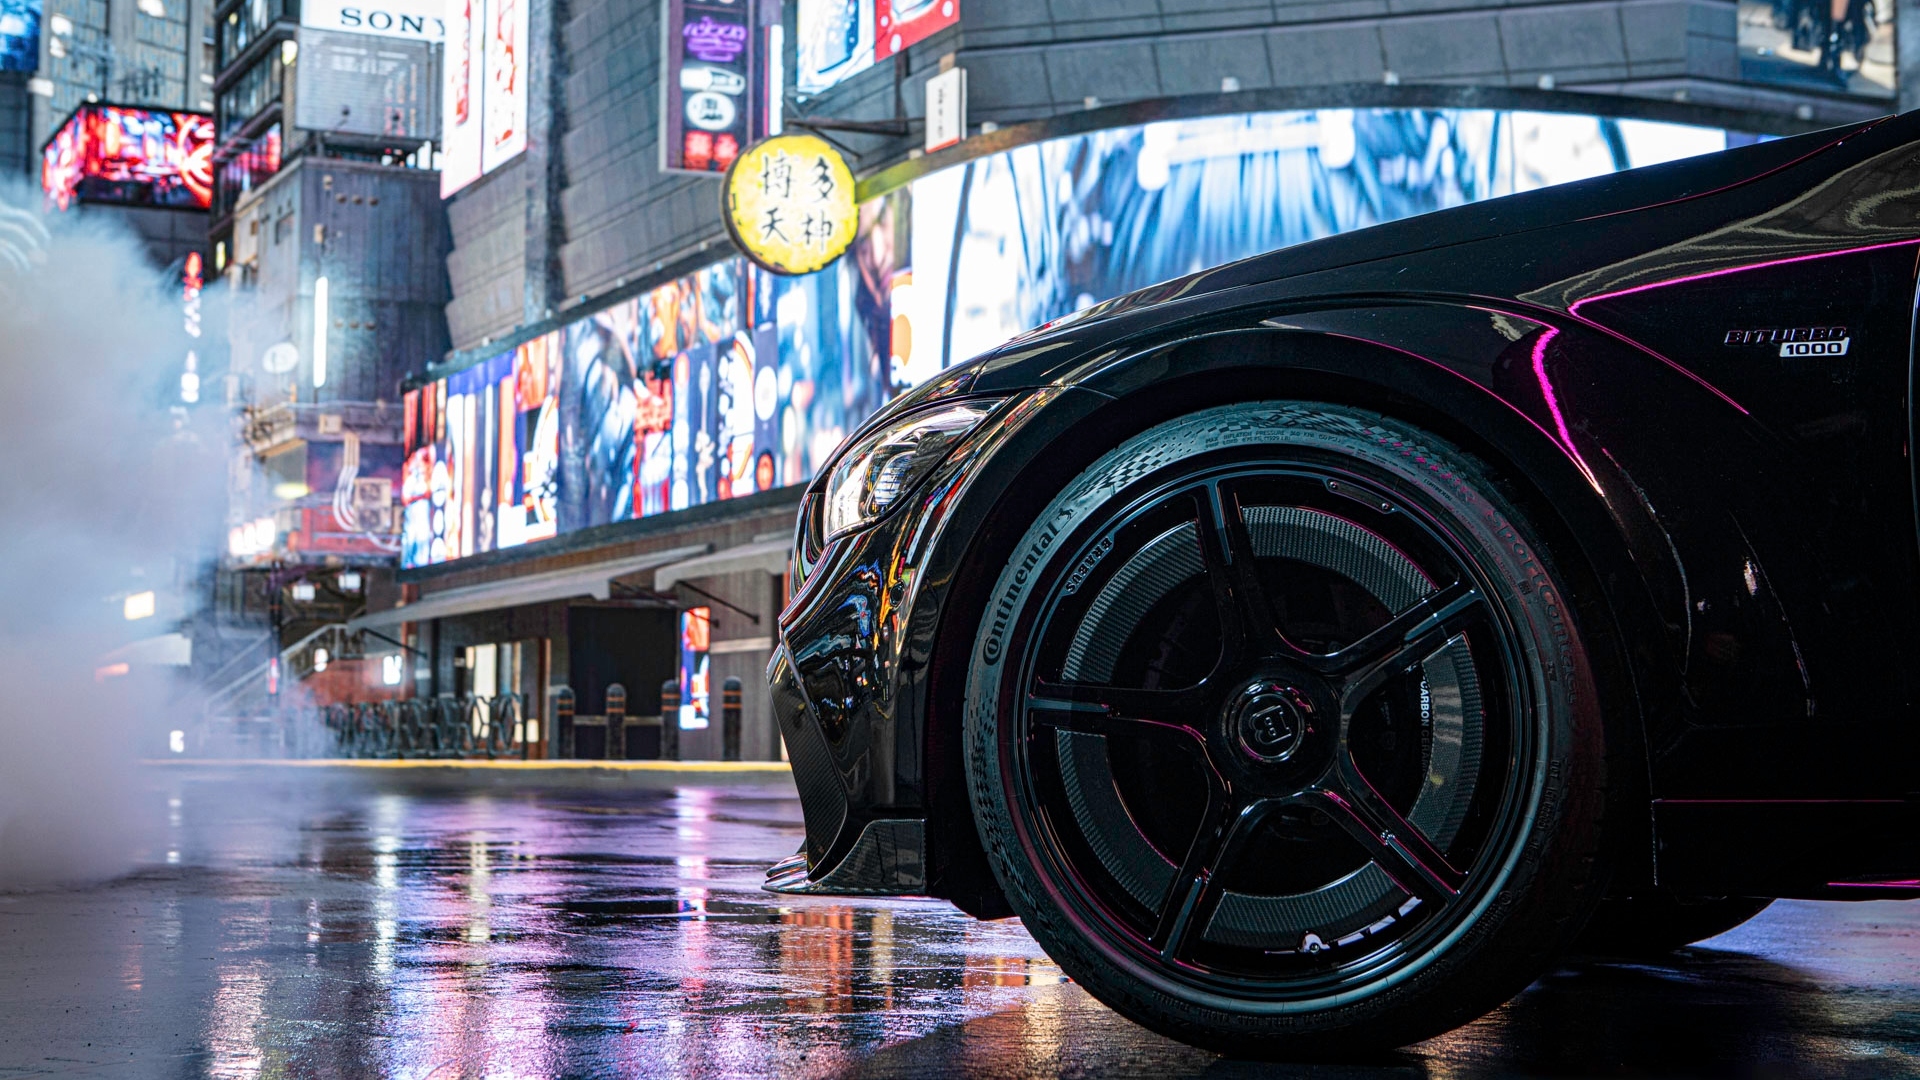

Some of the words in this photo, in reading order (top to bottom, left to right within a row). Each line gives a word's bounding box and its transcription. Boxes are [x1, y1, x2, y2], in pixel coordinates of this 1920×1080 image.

[762, 151, 835, 203] 博多
[761, 207, 834, 252] 天神
[1724, 326, 1846, 343] BITURBO
[1785, 343, 1842, 355] 1000
[1066, 537, 1112, 593] BRABUS
[982, 522, 1061, 666] Continental
[1420, 680, 1430, 727] CARBON
